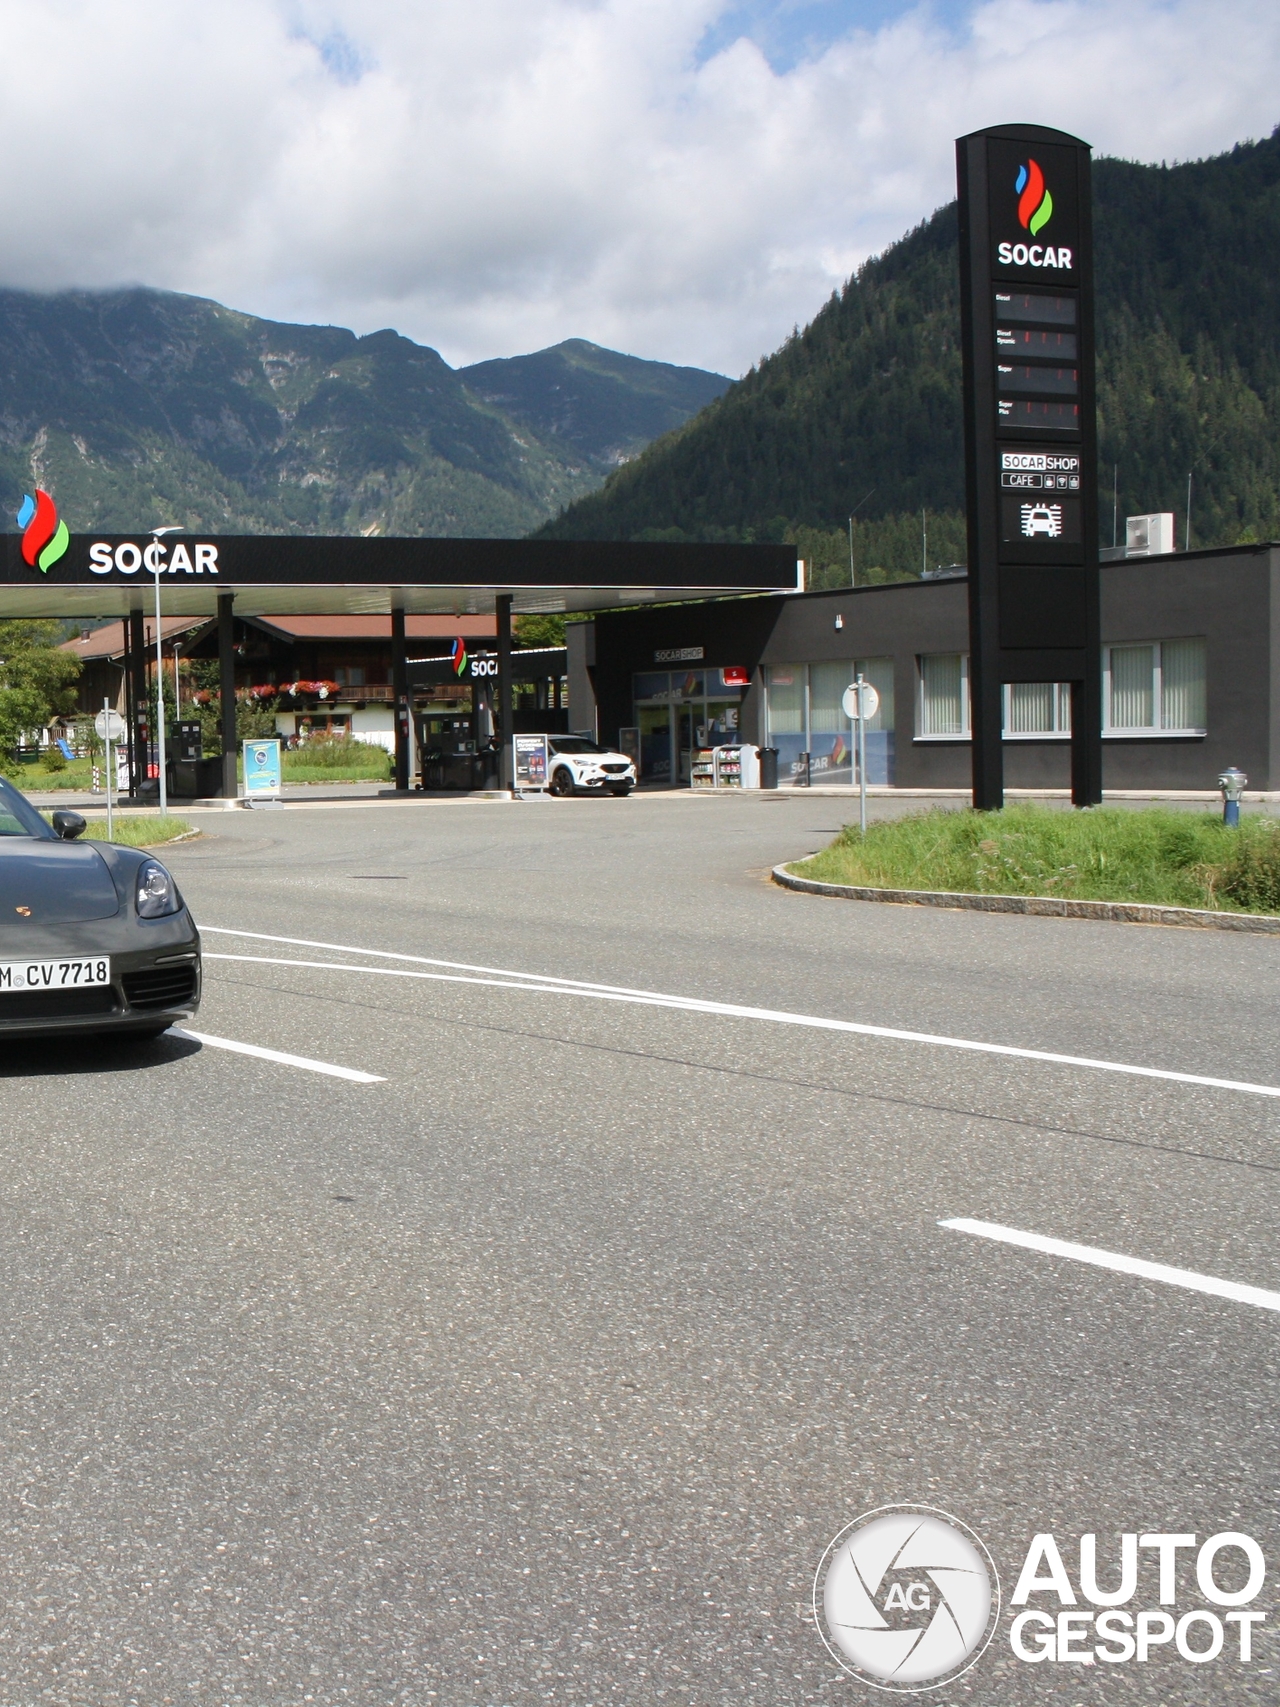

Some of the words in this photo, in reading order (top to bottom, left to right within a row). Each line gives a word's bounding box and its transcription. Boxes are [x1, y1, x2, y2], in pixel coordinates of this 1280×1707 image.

[998, 242, 1072, 269] SOCAR
[1009, 474, 1034, 486] CAFE
[89, 542, 219, 574] SOCAR
[471, 660, 498, 676] SOC
[27, 965, 53, 986] CV
[59, 961, 107, 984] 7718
